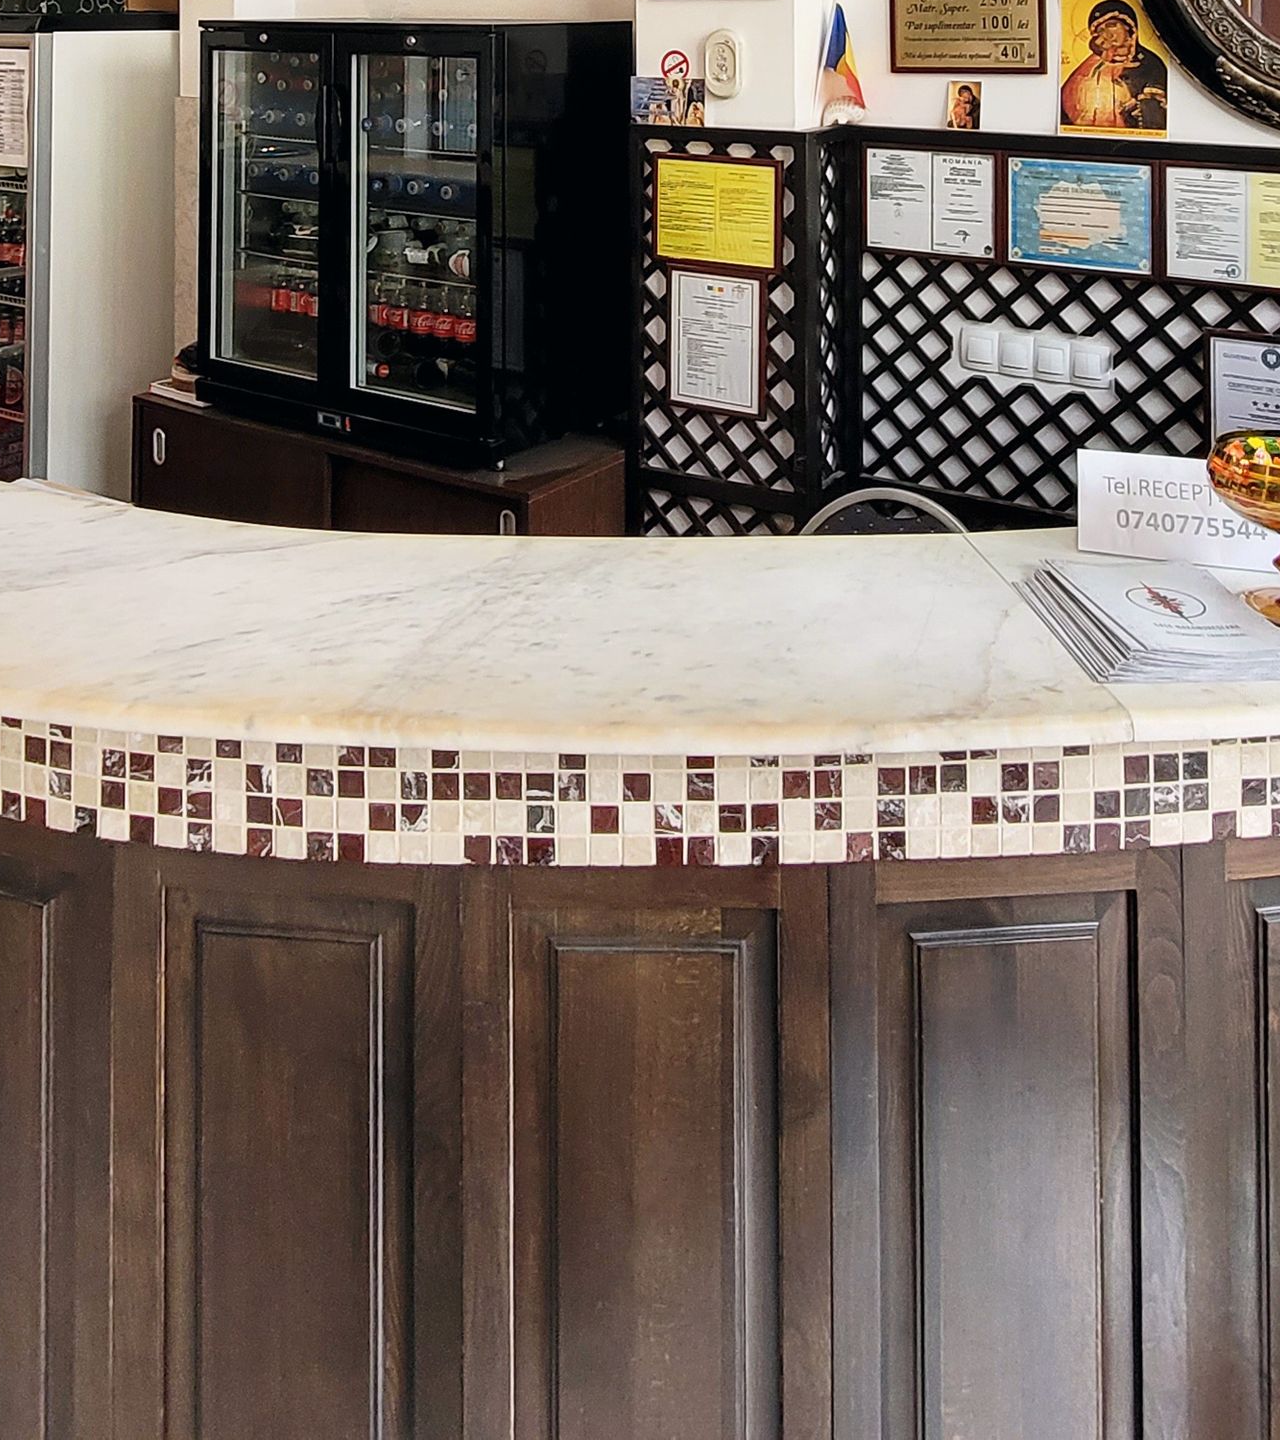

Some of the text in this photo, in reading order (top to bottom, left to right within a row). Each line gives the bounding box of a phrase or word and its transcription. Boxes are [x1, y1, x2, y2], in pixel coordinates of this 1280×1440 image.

[904, 20, 924, 31] Pat
[981, 15, 1010, 30] 100
[1016, 19, 1030, 30] lei
[1000, 45, 1019, 59] 40
[1116, 508, 1269, 541] 0740775544
